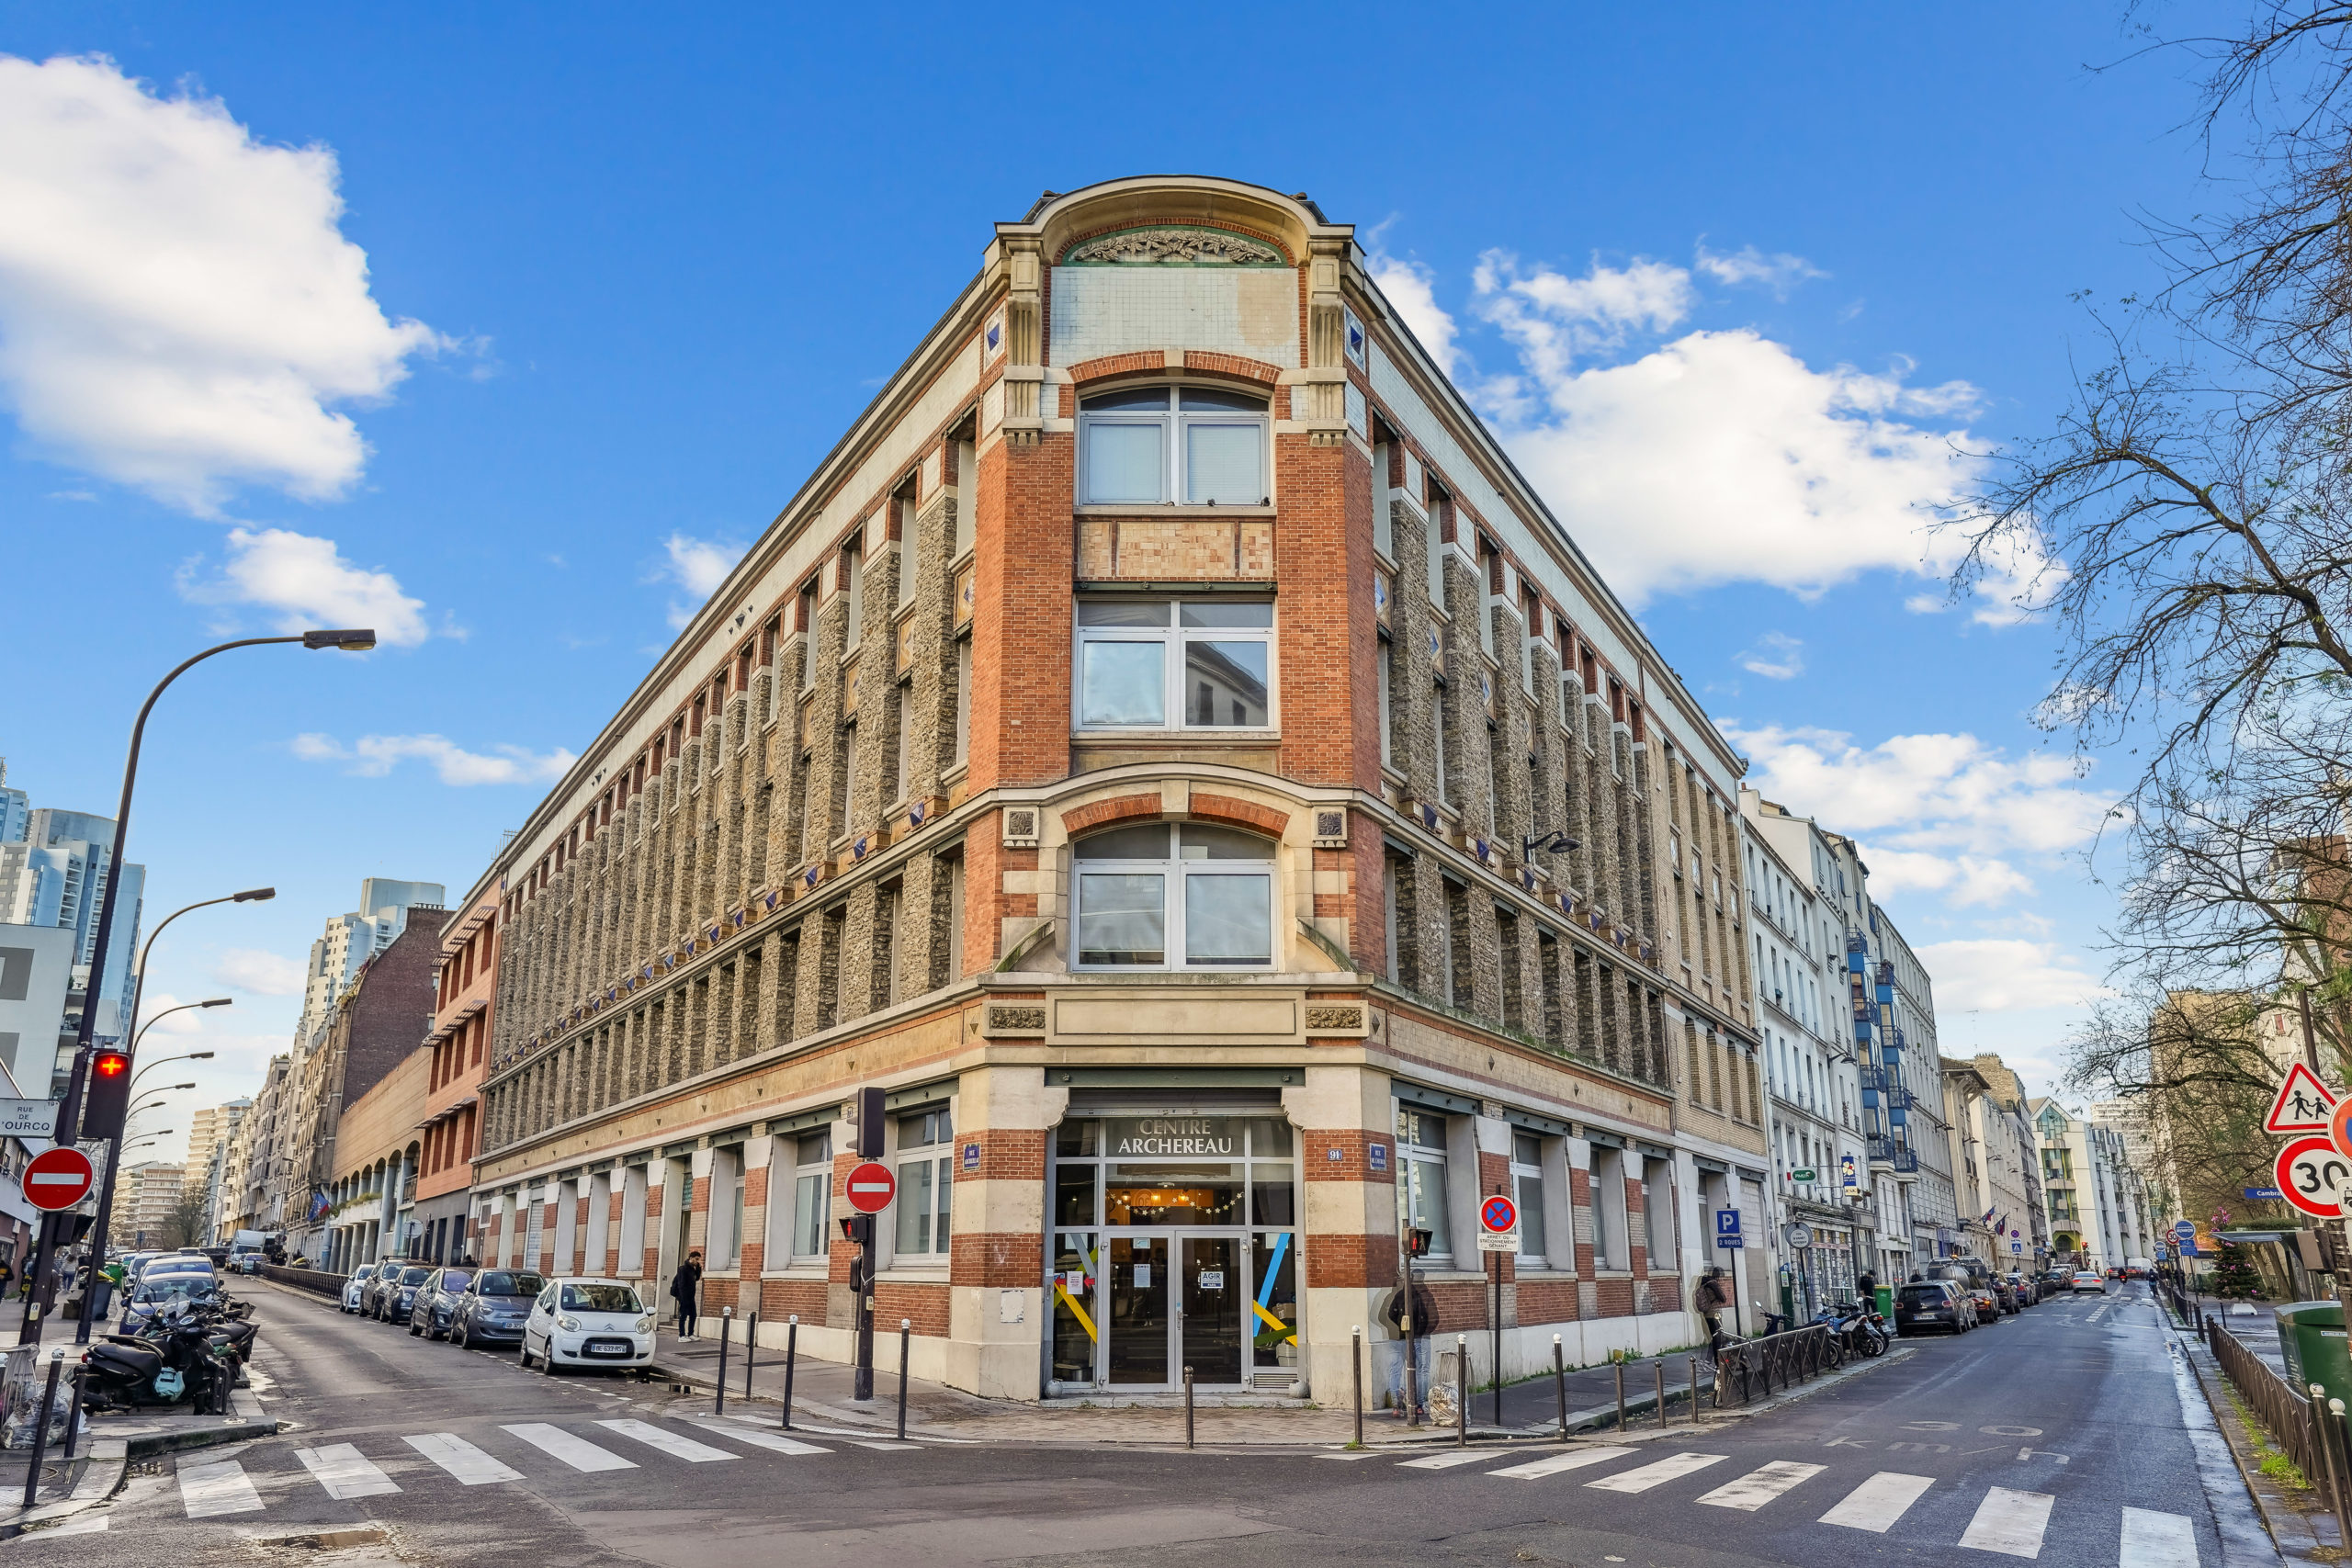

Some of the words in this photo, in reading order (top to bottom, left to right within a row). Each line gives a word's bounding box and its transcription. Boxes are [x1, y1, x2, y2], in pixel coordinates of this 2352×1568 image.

[0, 1121, 51, 1131] 'OURCQ
[1139, 1119, 1211, 1134] CENTRE
[1118, 1138, 1231, 1154] ARCHEREAU
[1329, 1150, 1340, 1159] 91
[2294, 1160, 2350, 1193] 30
[1722, 1213, 1734, 1231] P
